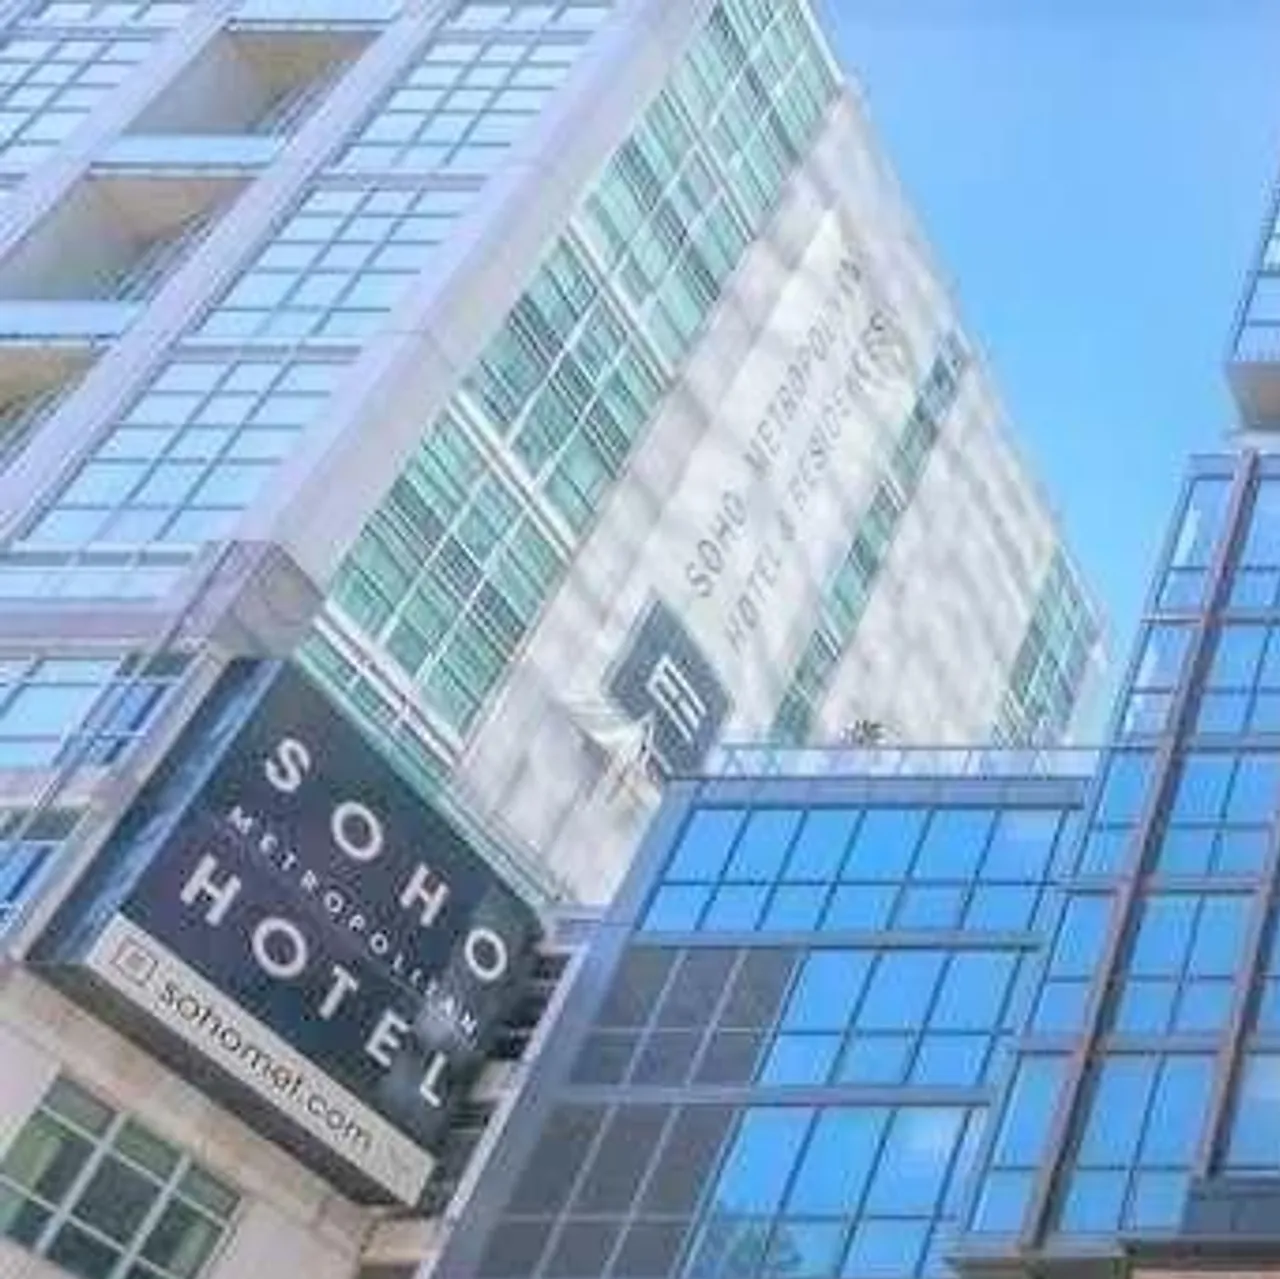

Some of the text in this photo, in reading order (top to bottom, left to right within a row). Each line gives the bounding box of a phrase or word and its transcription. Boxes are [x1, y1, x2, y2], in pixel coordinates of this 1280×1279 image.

[685, 489, 747, 598] SOHO
[723, 541, 782, 655] HOTEL
[229, 805, 479, 1036] METROPOLITAN
[265, 737, 508, 981] SOHO
[160, 981, 374, 1152] sohomet.com
[180, 854, 448, 1108] HOTEL
